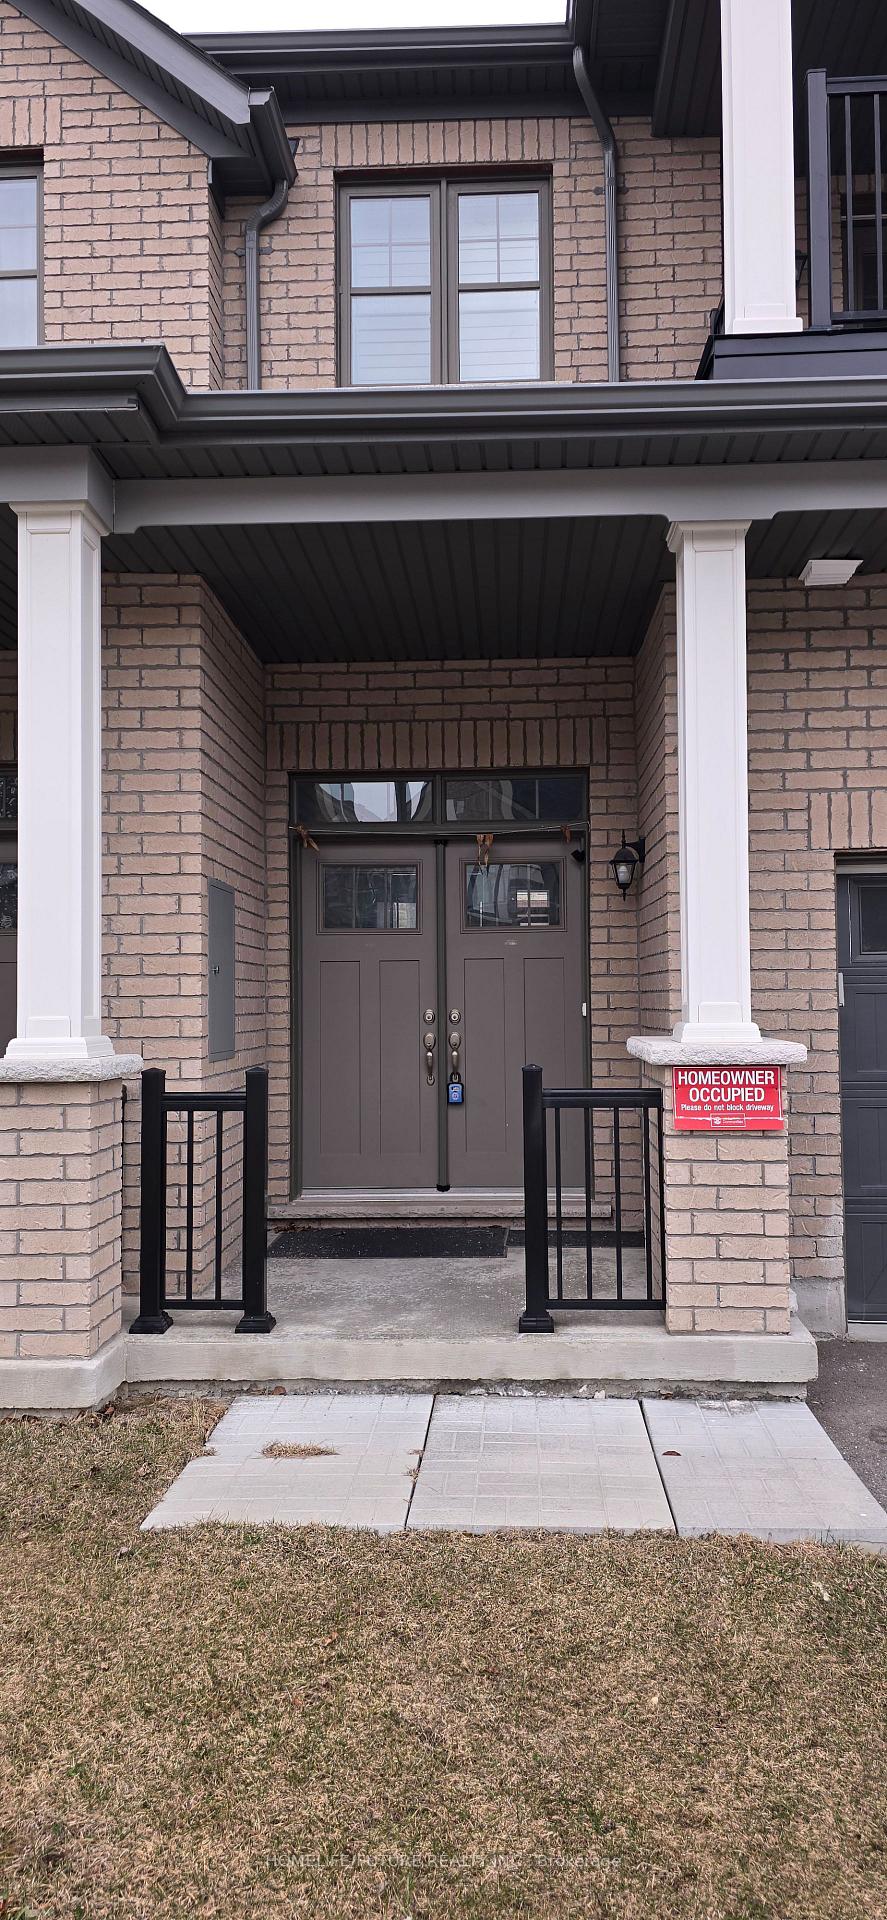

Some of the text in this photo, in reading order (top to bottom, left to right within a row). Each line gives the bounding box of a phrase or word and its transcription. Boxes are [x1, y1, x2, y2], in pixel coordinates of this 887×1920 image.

[678, 1070, 775, 1085] HOMEOWNER
[689, 1087, 765, 1102] OCCUPIED
[680, 1103, 775, 1112] Please do not block driveway
